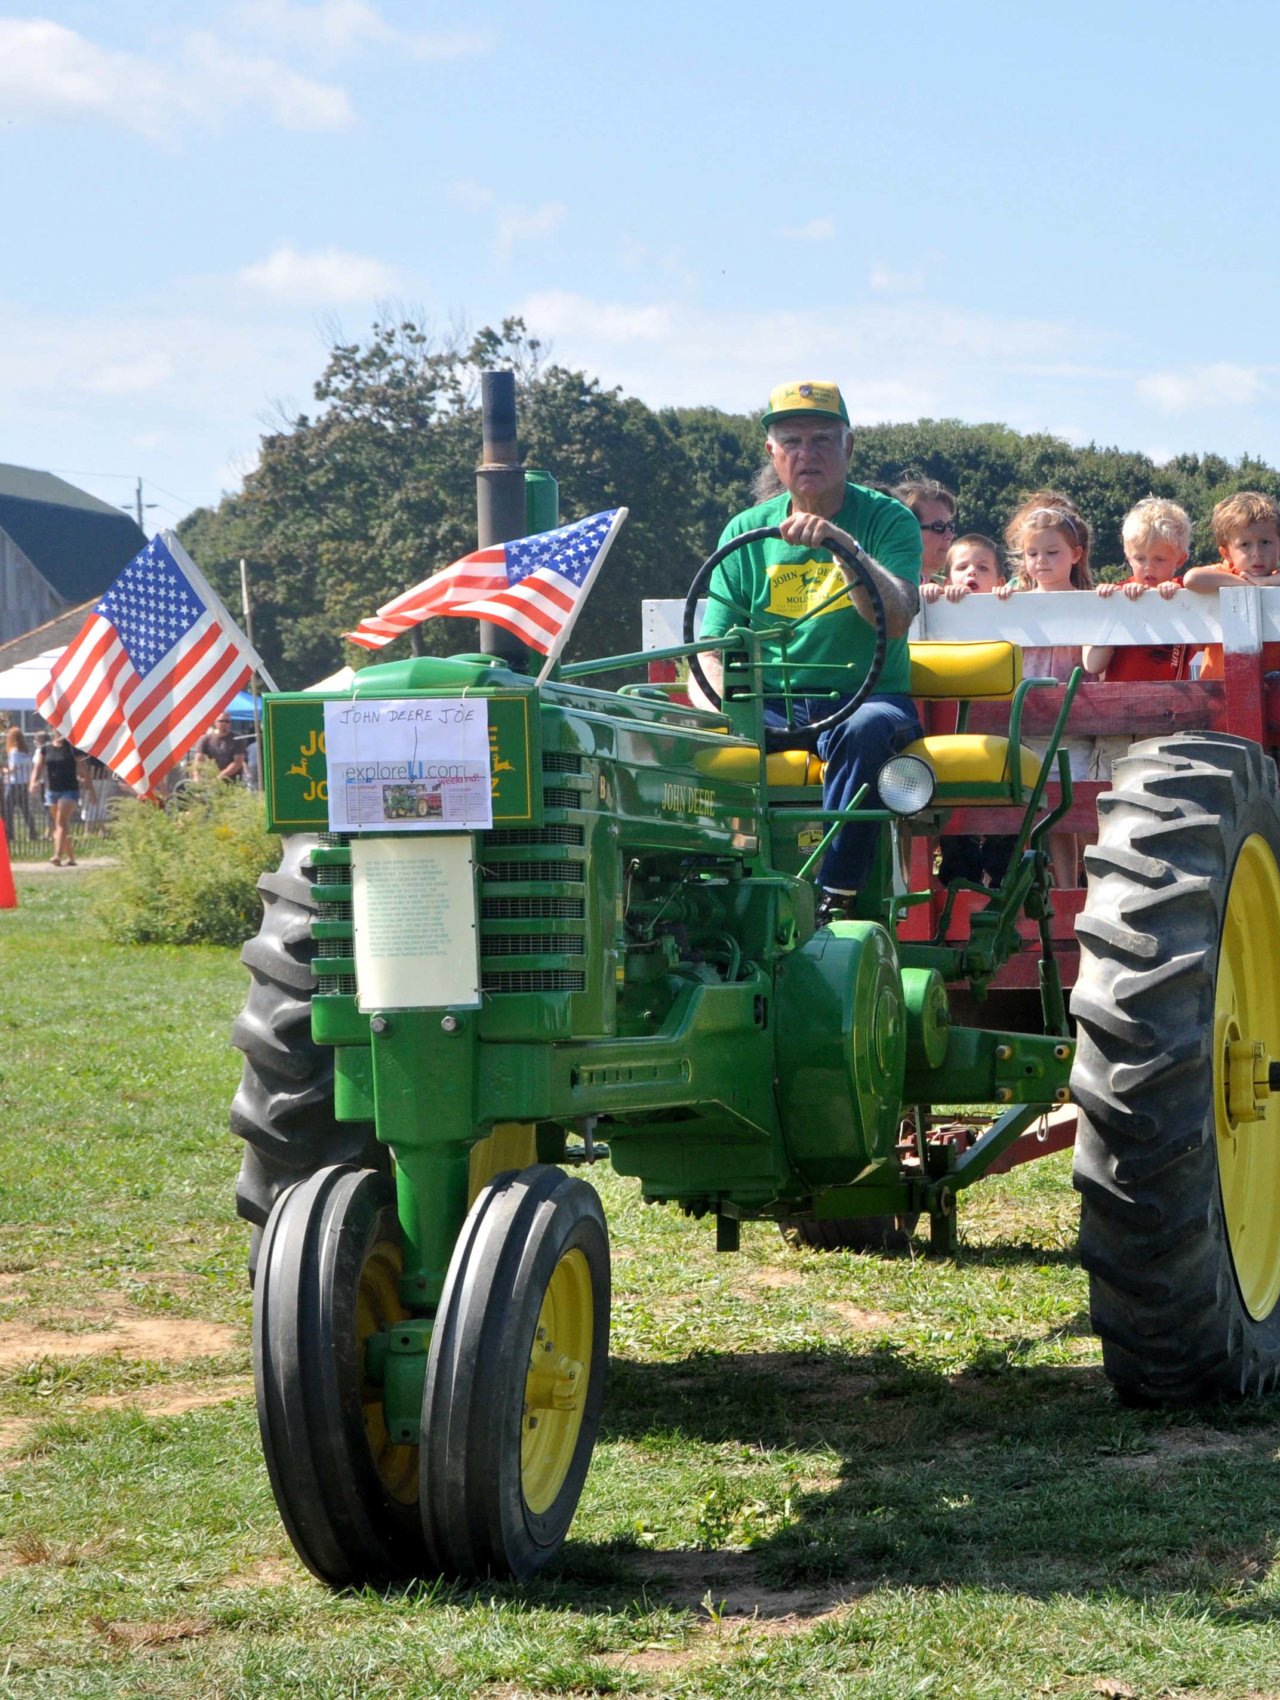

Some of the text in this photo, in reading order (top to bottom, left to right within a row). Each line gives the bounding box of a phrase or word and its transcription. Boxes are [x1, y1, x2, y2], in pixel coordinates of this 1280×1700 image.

[773, 569, 798, 588] JOHN
[339, 708, 475, 724] JOHN DEERE JOE
[438, 773, 480, 785] weeknd!
[600, 775, 606, 800] B
[662, 783, 715, 817] JOHN DEERE
